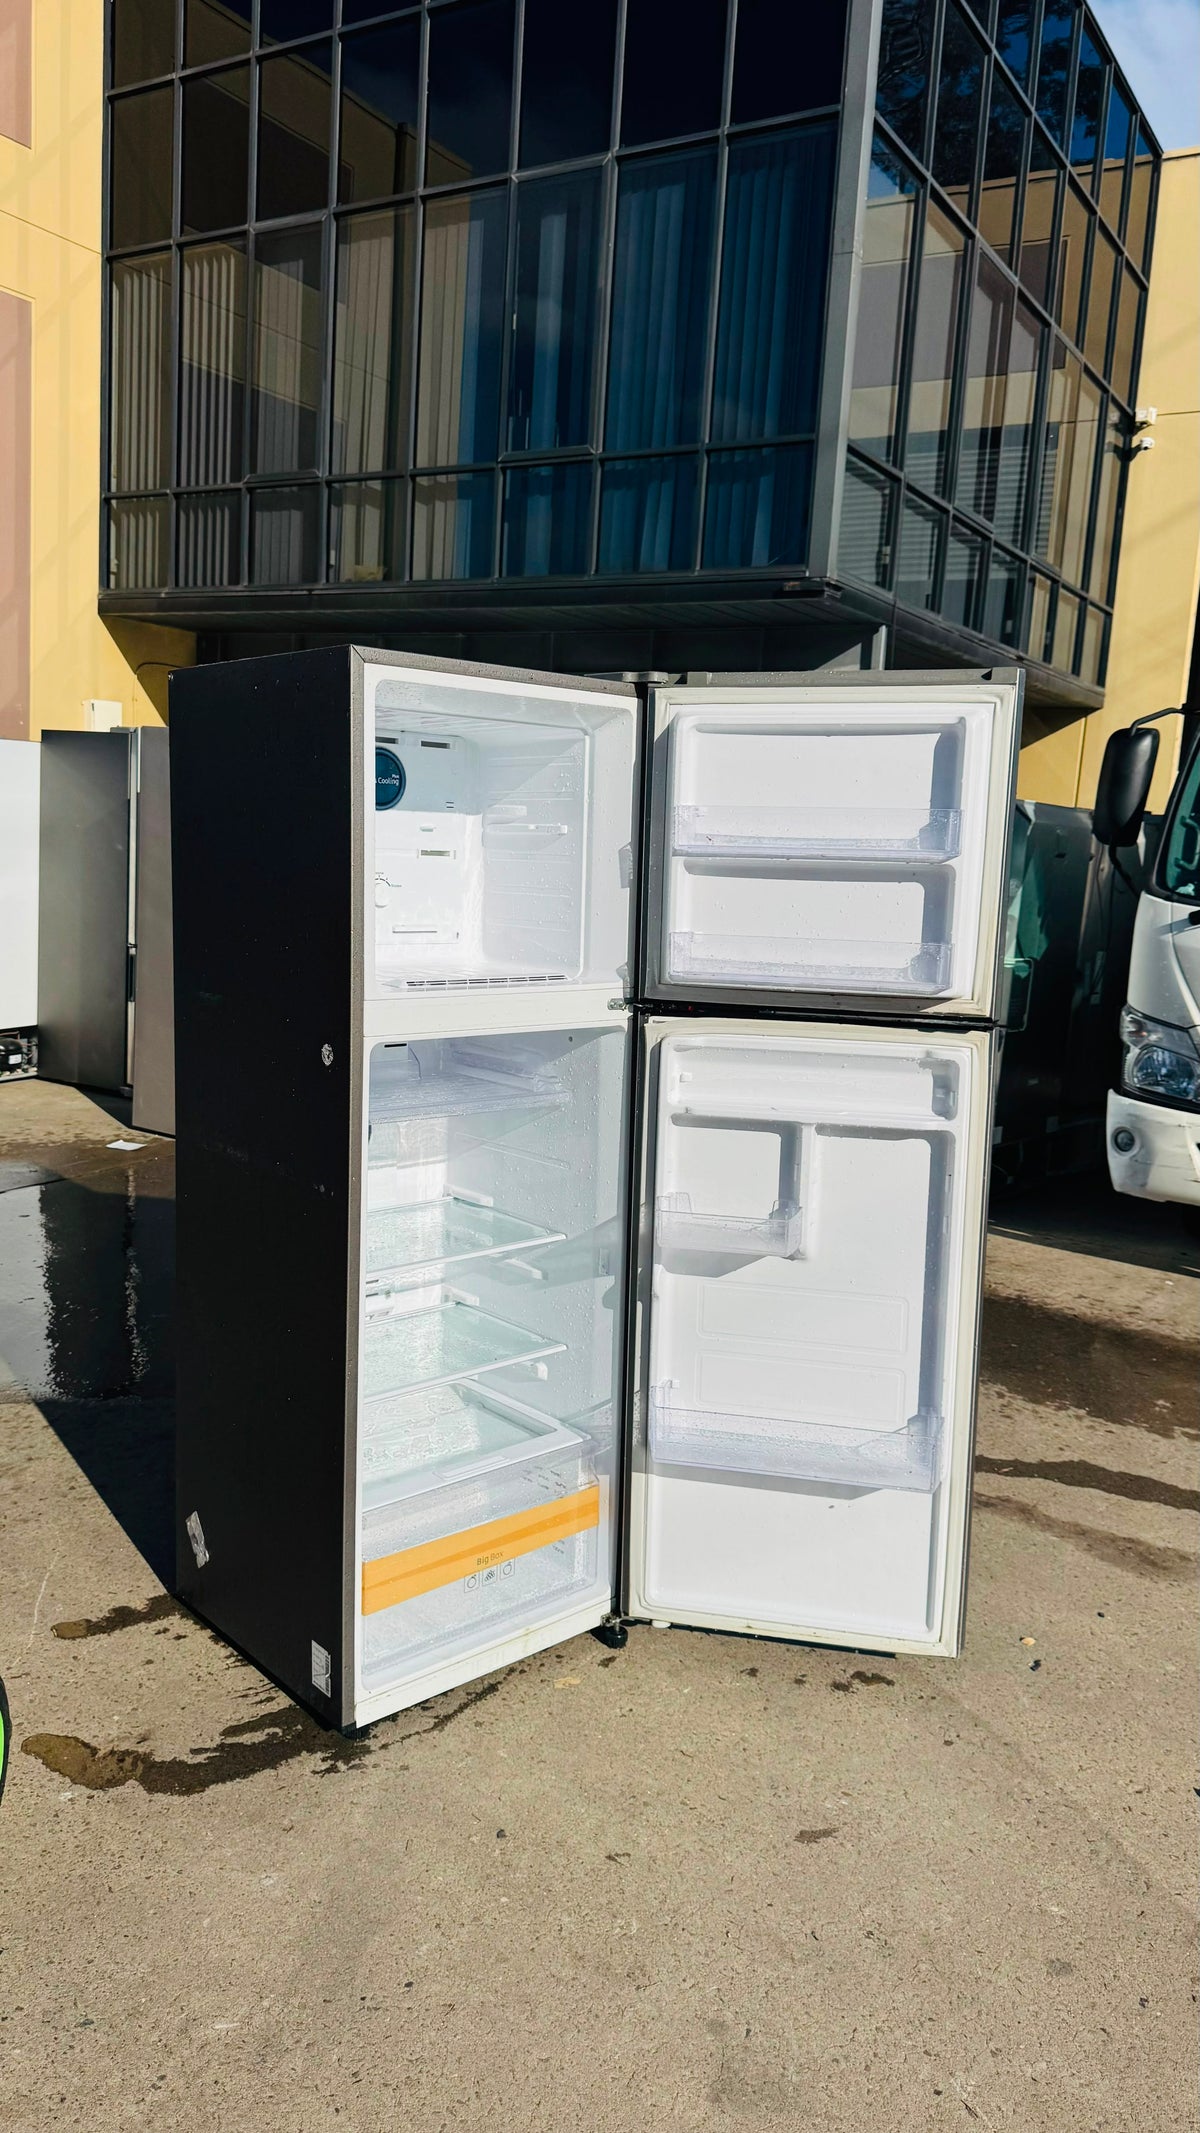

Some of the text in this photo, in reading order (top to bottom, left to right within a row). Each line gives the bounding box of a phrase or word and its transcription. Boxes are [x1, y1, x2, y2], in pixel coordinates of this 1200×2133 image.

[378, 776, 399, 786] Cooling
[476, 1552, 503, 1566] Big Box
